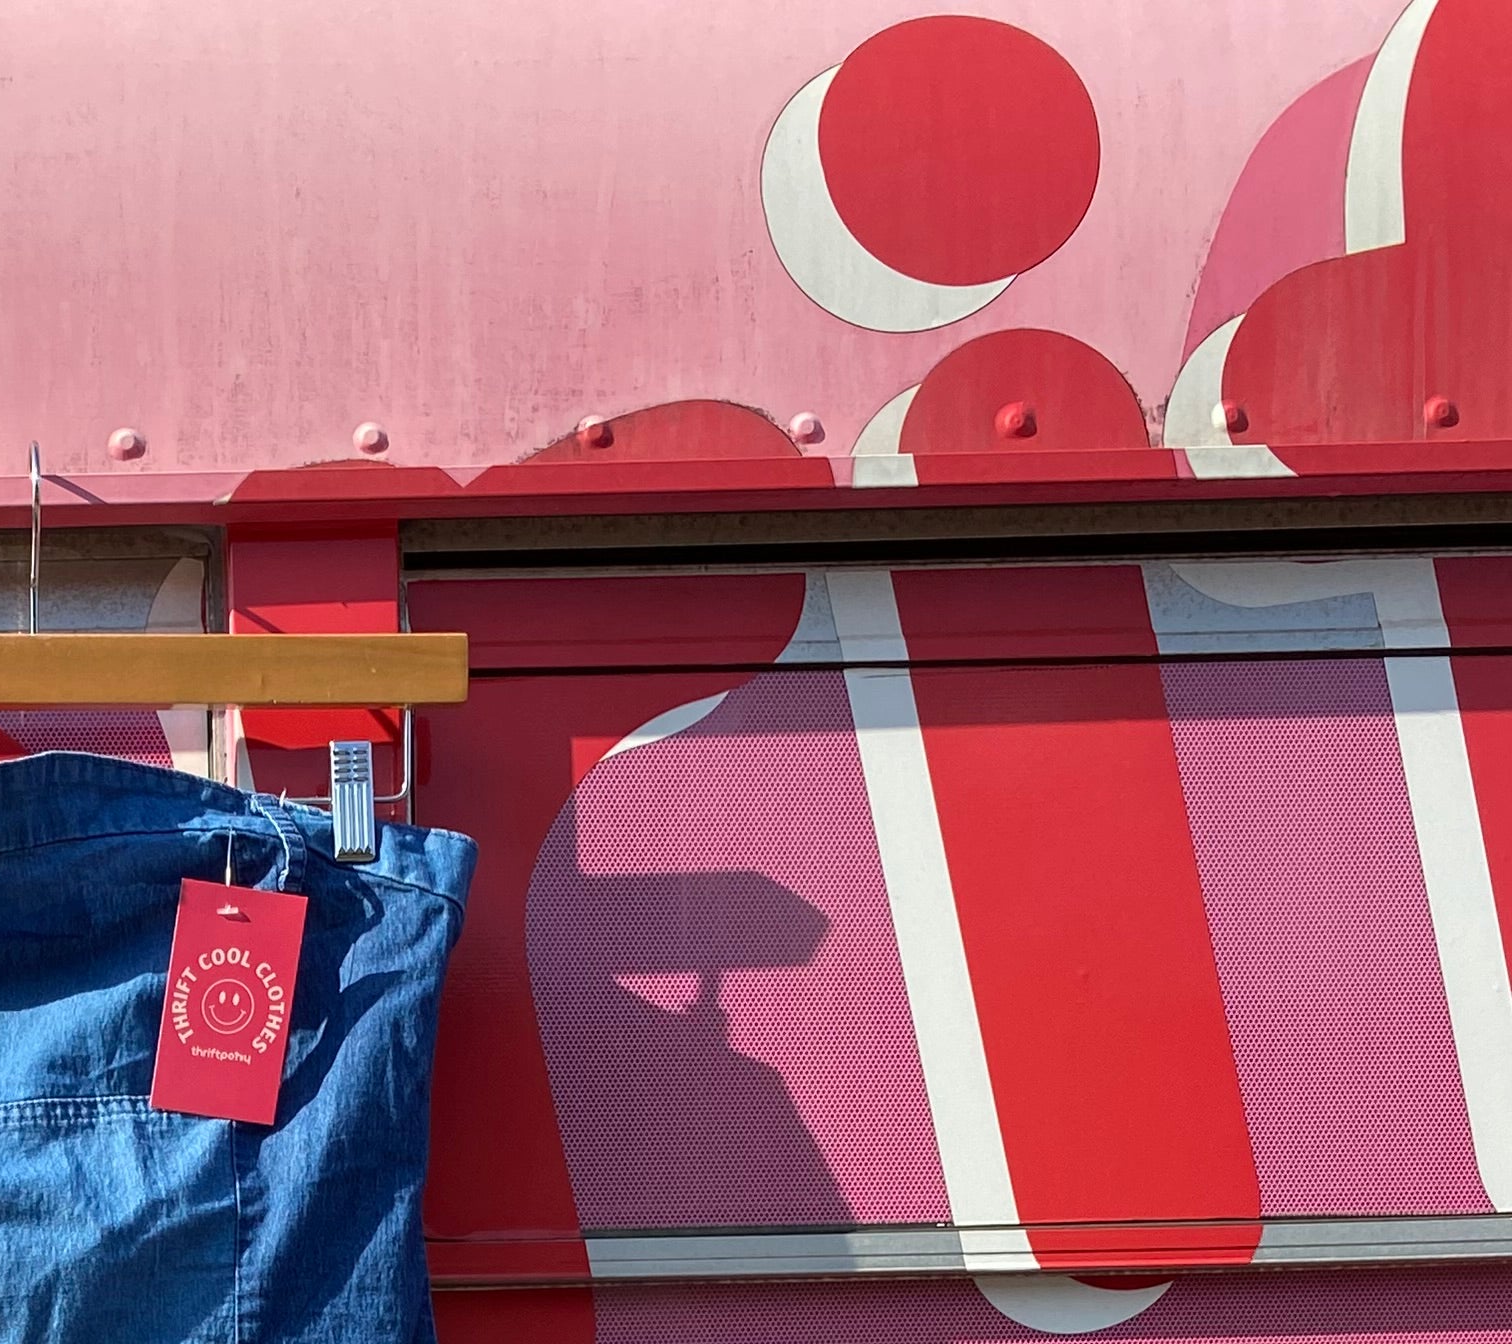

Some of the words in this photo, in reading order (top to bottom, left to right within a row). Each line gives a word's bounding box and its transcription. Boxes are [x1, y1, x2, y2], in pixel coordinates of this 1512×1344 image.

[171, 966, 198, 1045] THRIFT
[198, 947, 251, 971] COOL
[251, 961, 285, 1054] CLOTHES
[191, 1045, 252, 1066] thriftpony
